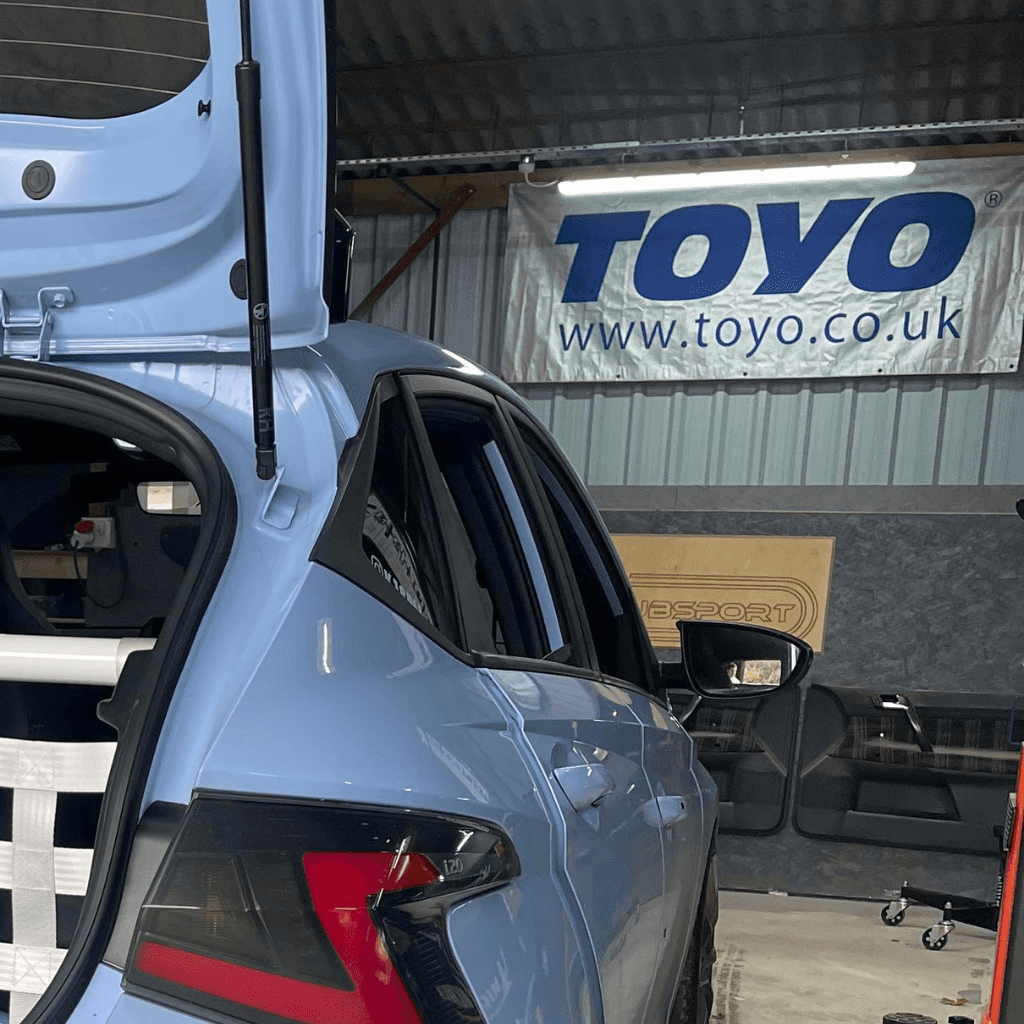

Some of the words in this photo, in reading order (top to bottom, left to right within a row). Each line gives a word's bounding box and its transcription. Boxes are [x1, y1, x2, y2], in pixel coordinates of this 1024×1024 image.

[556, 191, 975, 303] TOYO
[558, 296, 962, 358] www.toyo.co.uk
[443, 858, 464, 876] i20
